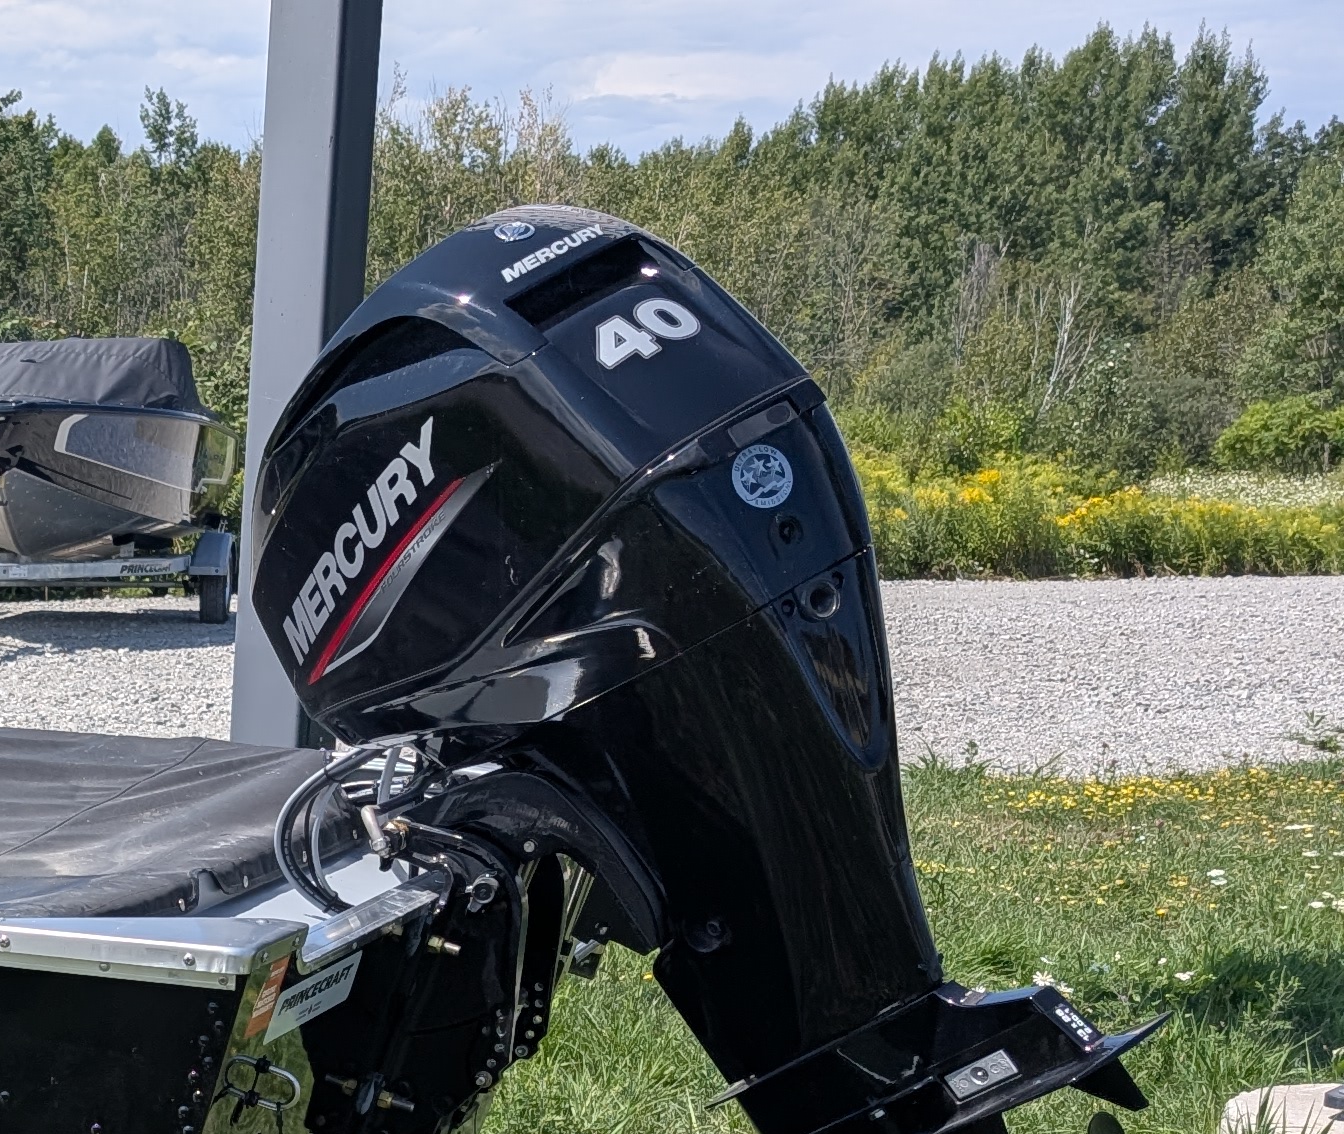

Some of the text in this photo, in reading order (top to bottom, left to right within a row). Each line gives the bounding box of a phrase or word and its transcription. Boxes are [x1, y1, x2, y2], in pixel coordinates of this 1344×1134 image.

[501, 224, 604, 283] MERCURY
[596, 298, 701, 370] 40
[283, 416, 435, 666] MERCURY
[380, 511, 446, 593] FOURSTROKE
[278, 963, 354, 1016] PRINCECRAFT
